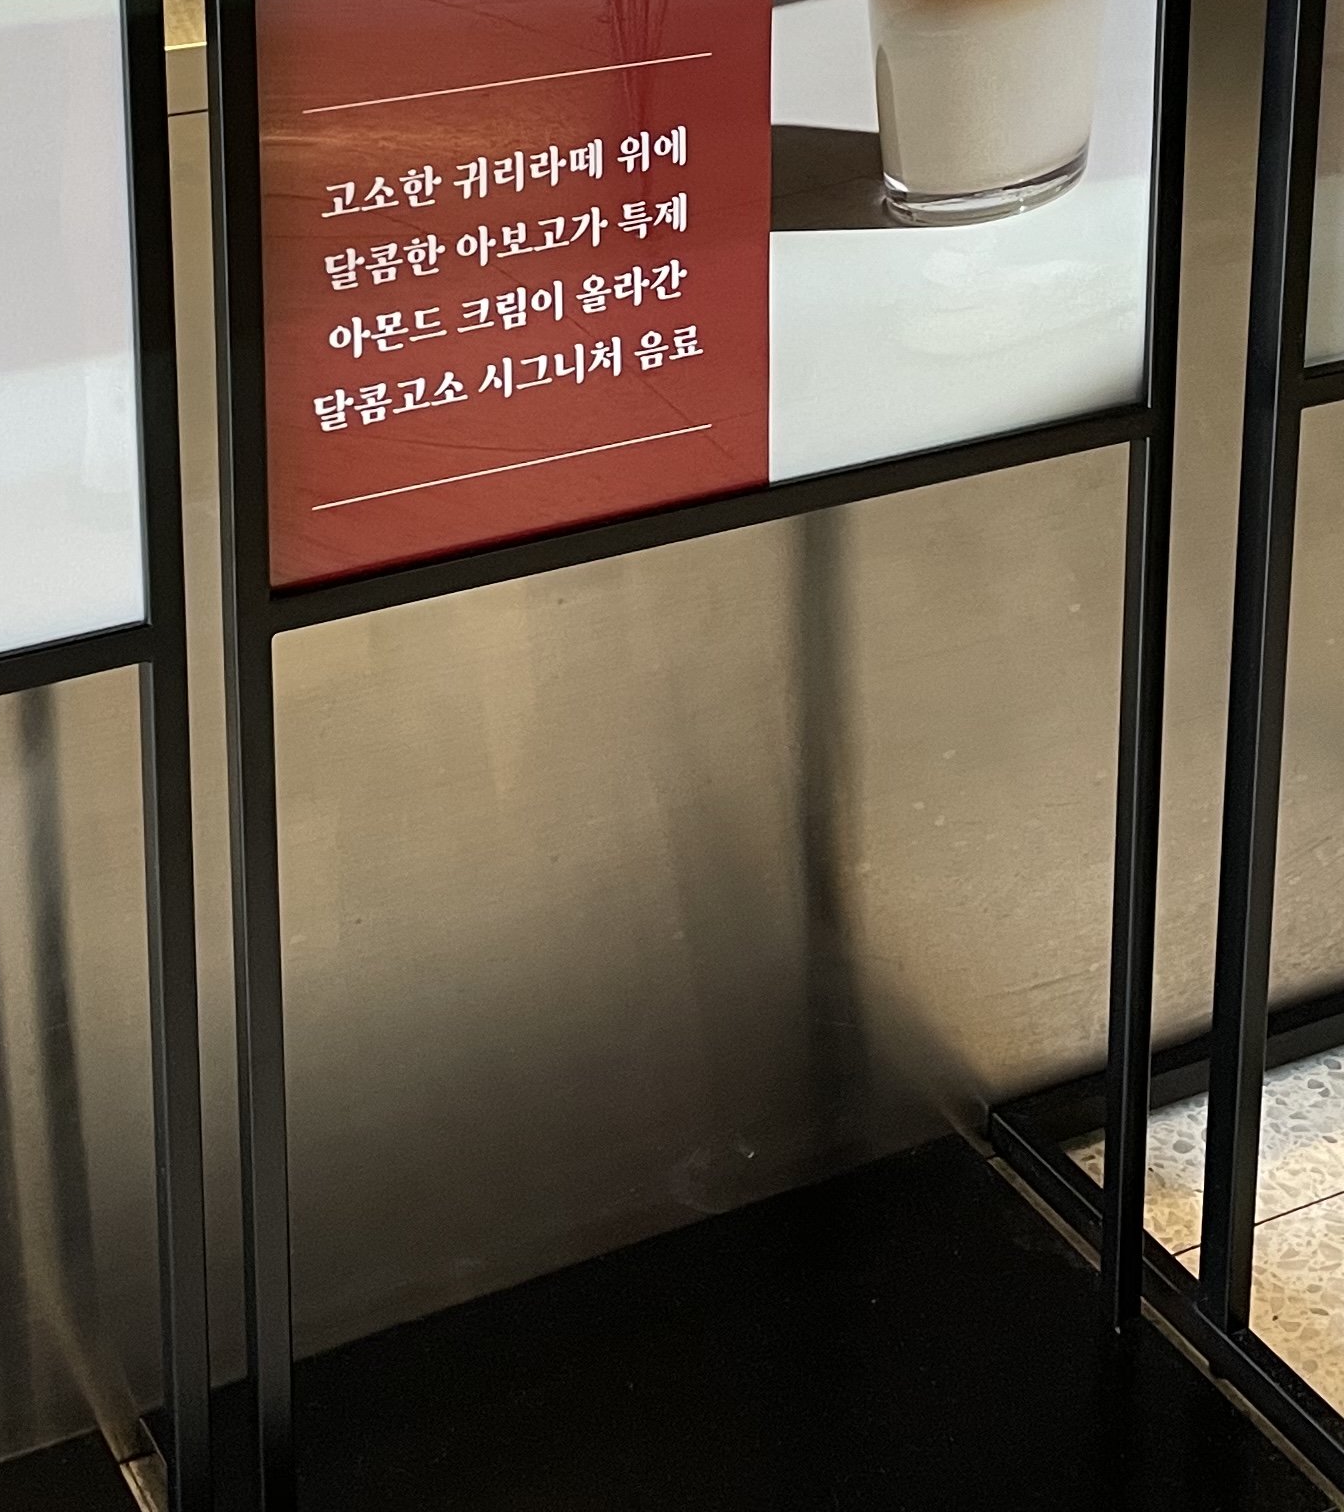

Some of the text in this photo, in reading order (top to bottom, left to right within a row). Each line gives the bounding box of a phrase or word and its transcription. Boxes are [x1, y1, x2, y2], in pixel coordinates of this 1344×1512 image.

[321, 126, 687, 218] 고소한 귀리라떼 위에
[325, 193, 687, 290] 달콤한 아보고가 특제
[329, 260, 687, 358] 아몬드 크림이 올라간
[314, 326, 703, 432] 달콤고소 시그니처 음료
